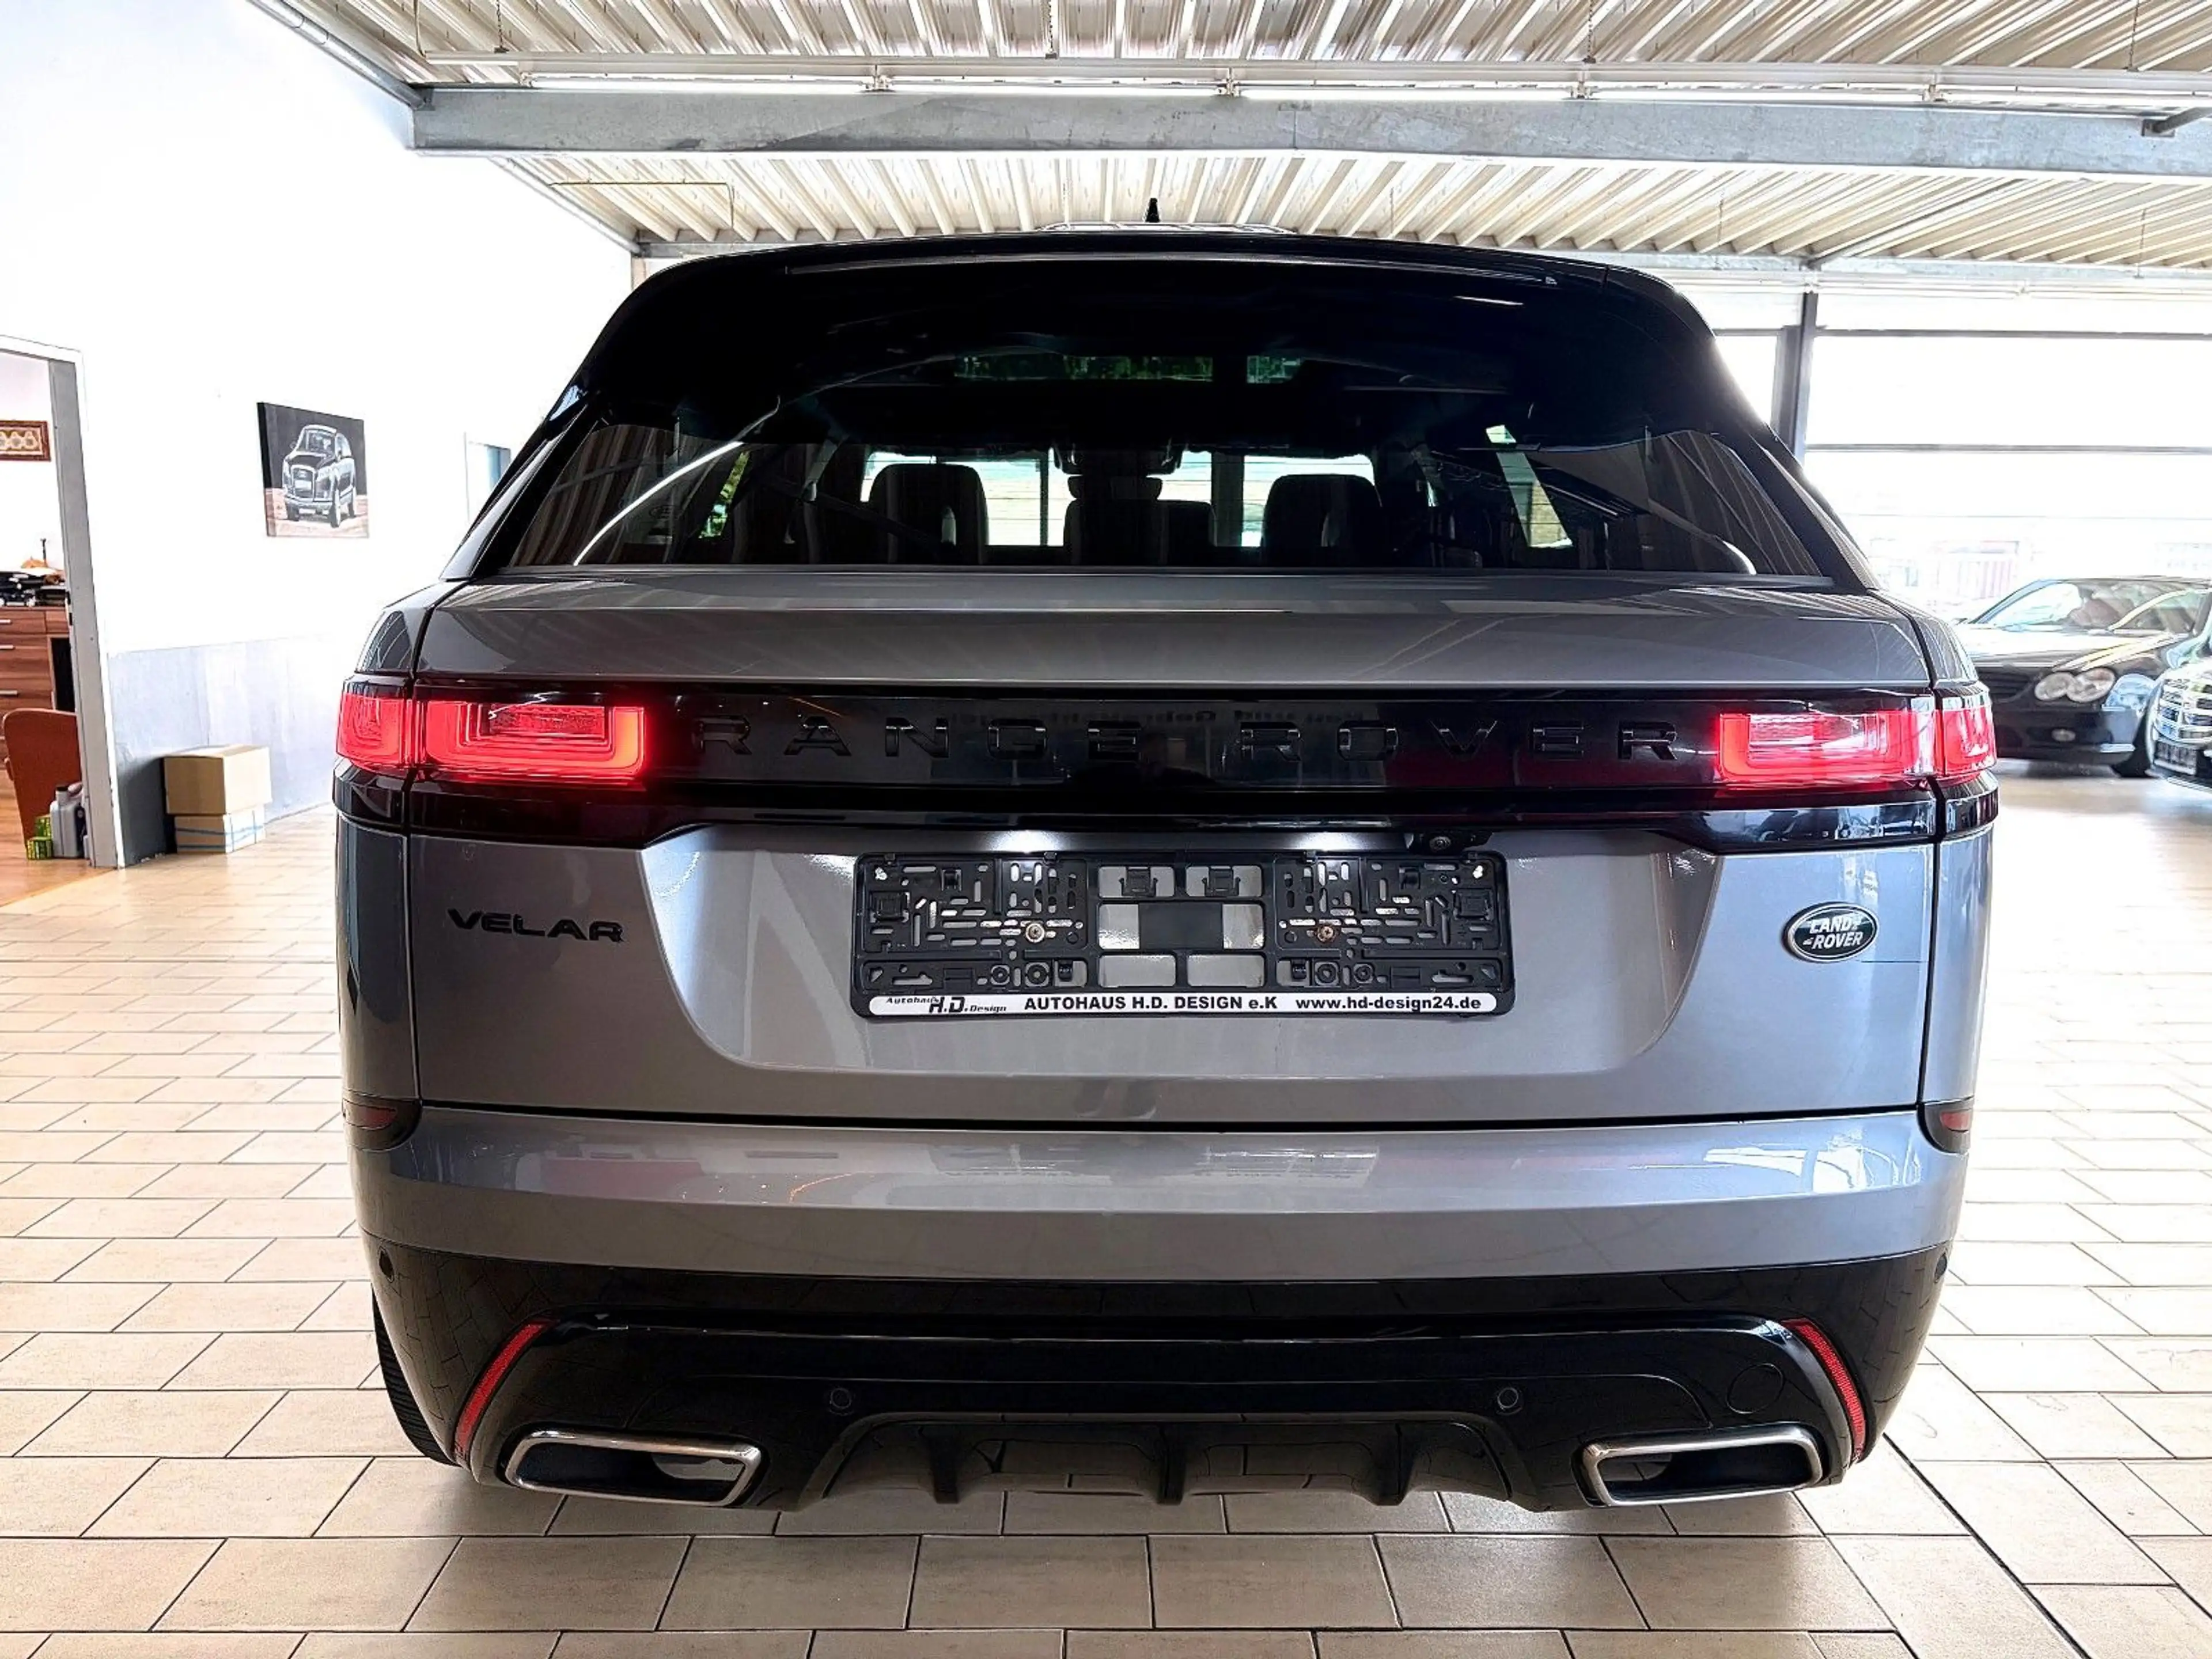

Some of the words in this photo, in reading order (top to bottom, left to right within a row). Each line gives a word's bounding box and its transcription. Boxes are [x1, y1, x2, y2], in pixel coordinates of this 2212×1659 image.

[691, 715, 1142, 760] RANGE
[1237, 718, 1680, 760] ROVER
[447, 908, 624, 942] VELAR
[1810, 914, 1852, 934] LAND
[1811, 931, 1864, 949] ROVER
[1024, 997, 1126, 1010] AUTOHAUS
[1132, 997, 1168, 1009] H.D.
[1175, 996, 1243, 1009] DESIGN
[1248, 996, 1278, 1009] e.K
[1296, 996, 1482, 1011] www.hd-design24.de
